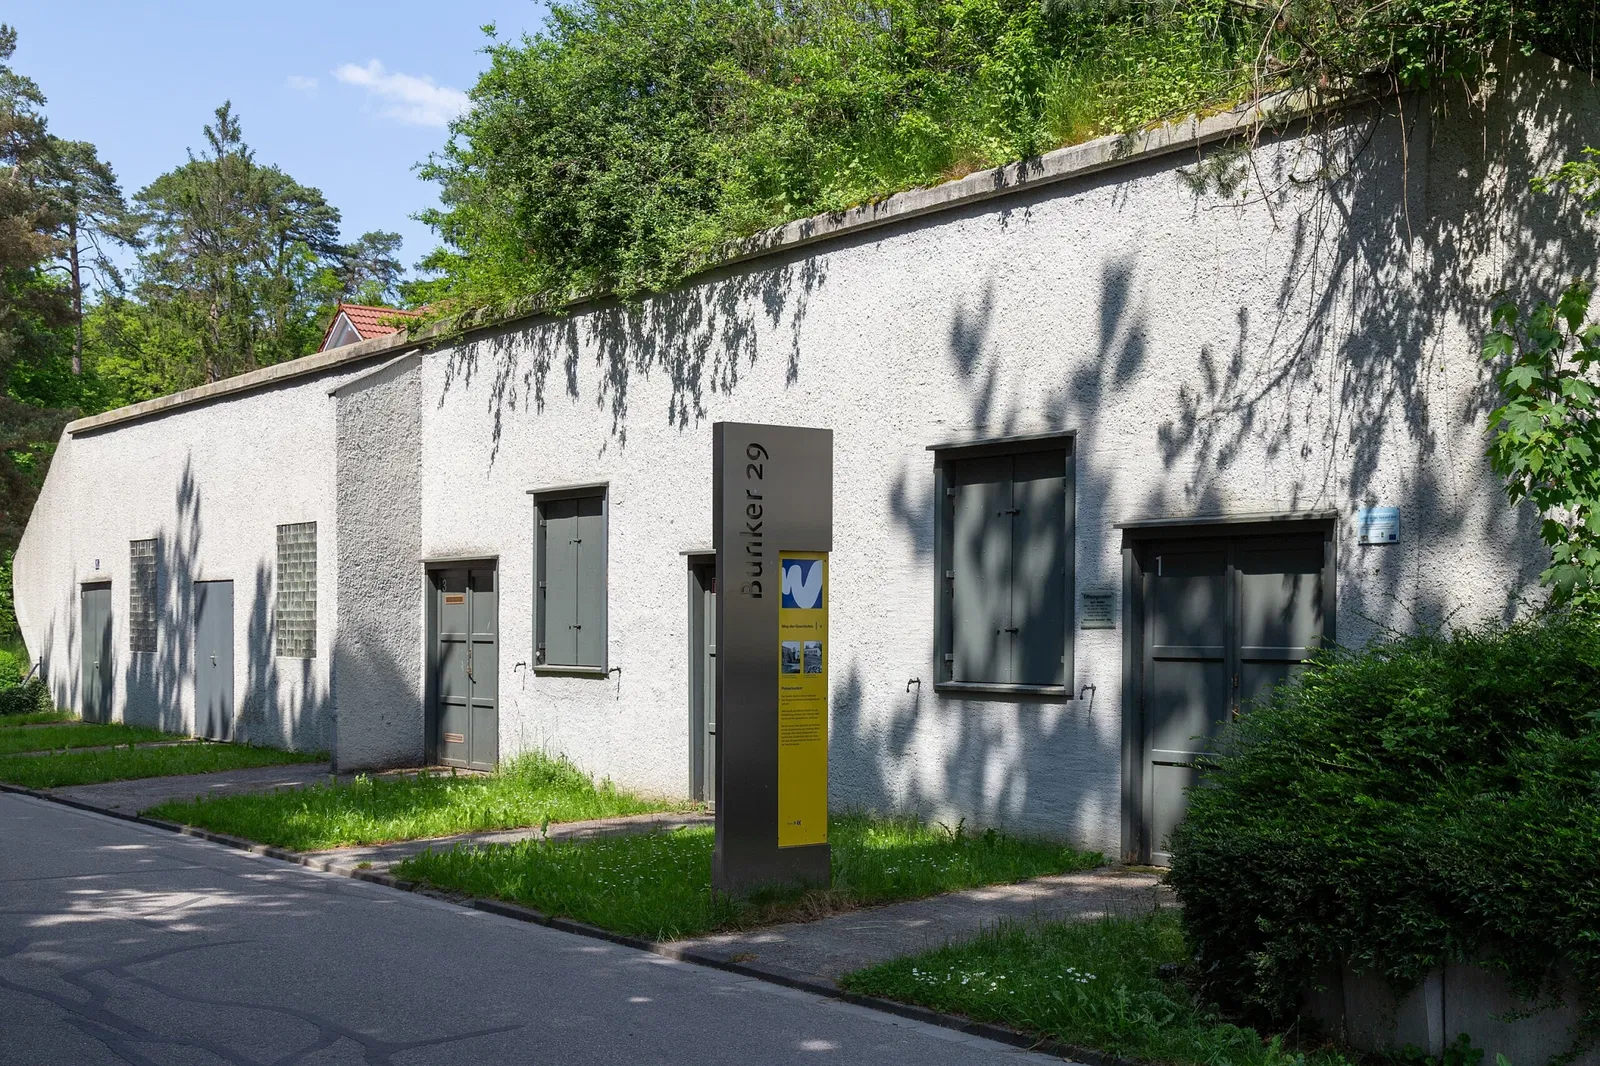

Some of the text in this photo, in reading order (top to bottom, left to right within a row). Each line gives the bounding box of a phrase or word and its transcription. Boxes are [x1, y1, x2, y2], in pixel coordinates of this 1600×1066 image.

[740, 443, 769, 599] Bunker 29
[1156, 556, 1162, 576] 1
[442, 579, 447, 592] 3
